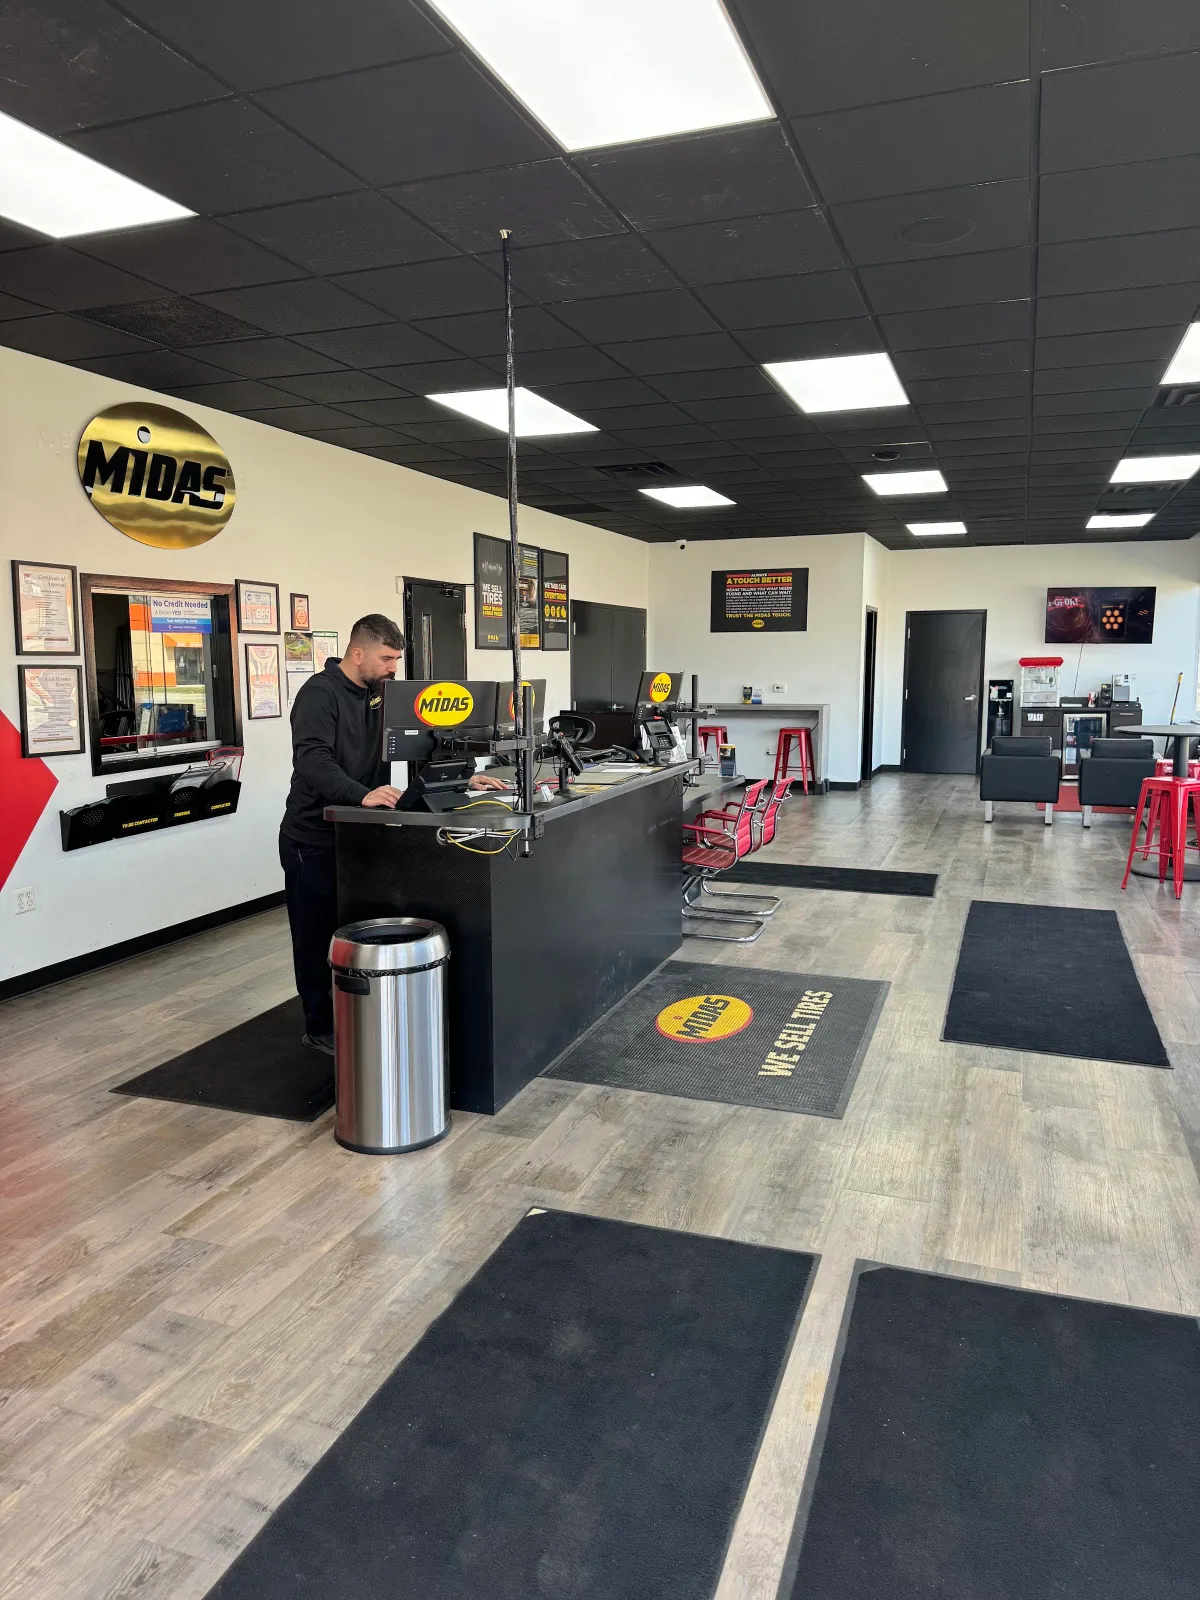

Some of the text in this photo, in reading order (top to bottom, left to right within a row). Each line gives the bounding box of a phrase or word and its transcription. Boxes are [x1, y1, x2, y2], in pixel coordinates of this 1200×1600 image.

[83, 439, 227, 511] MIDAS
[482, 583, 502, 593] WE SELL
[482, 592, 503, 606] TIRES
[652, 682, 670, 693] MIDAS
[420, 696, 469, 714] MIDAS
[134, 817, 158, 826] CONTACTED
[676, 996, 730, 1040] MIDAS
[758, 989, 834, 1077] WE SELL TIRES
